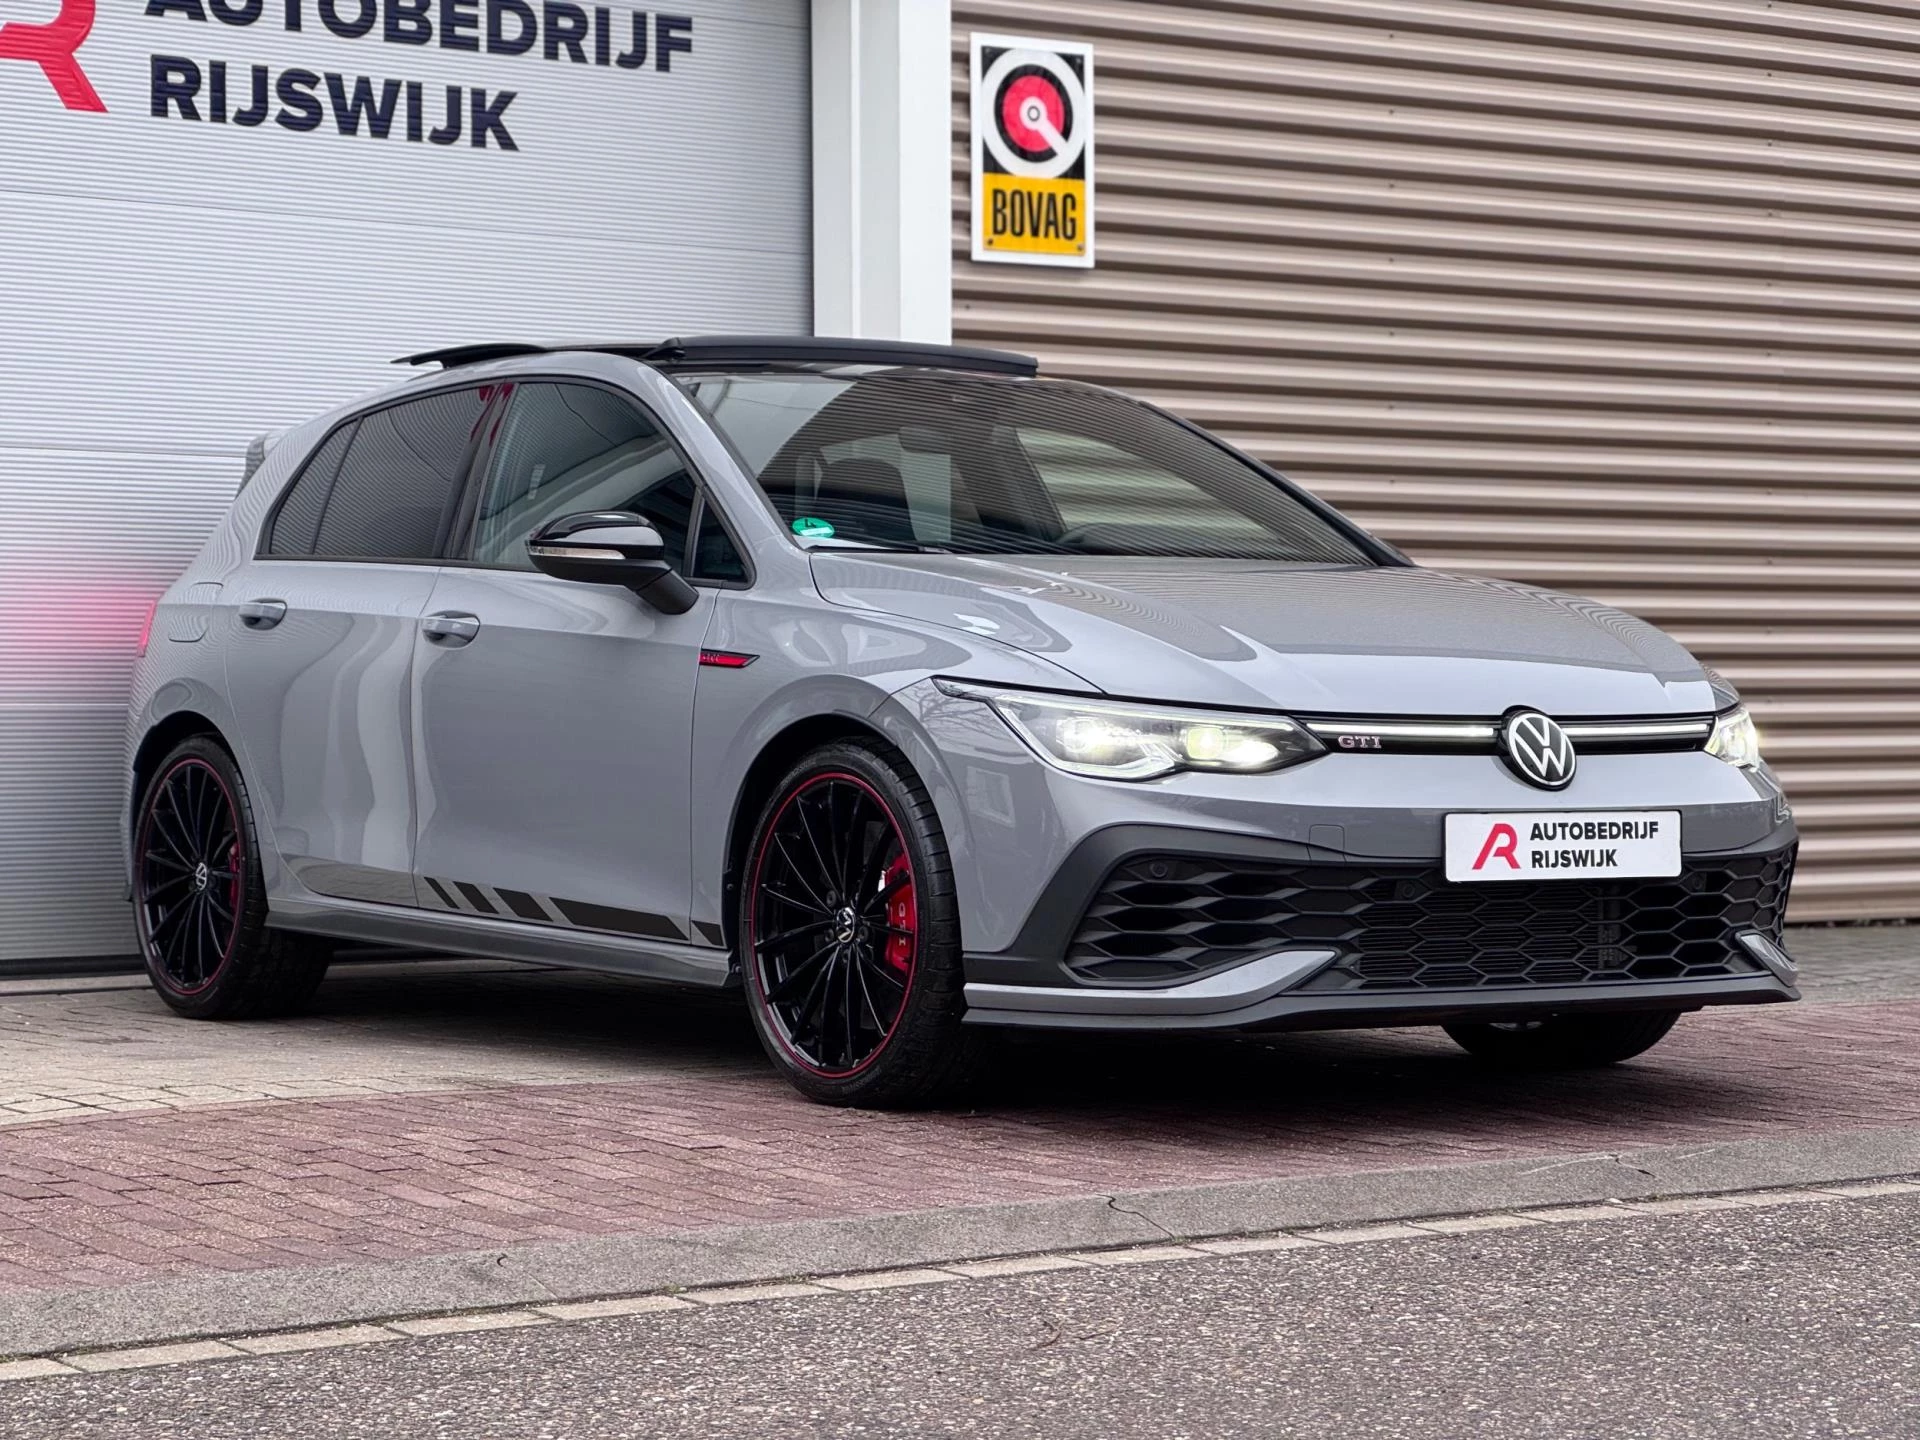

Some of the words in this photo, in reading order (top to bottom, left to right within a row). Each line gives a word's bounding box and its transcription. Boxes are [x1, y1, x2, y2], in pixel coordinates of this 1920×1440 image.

[144, 0, 692, 72] OBEDRIJF
[150, 54, 519, 151] RIJSWIJK
[992, 188, 1077, 240] BOVAG
[1337, 735, 1382, 749] GTI
[1530, 821, 1659, 841] AUTOBEDRIJF
[1531, 849, 1618, 869] RIJSWIJK
